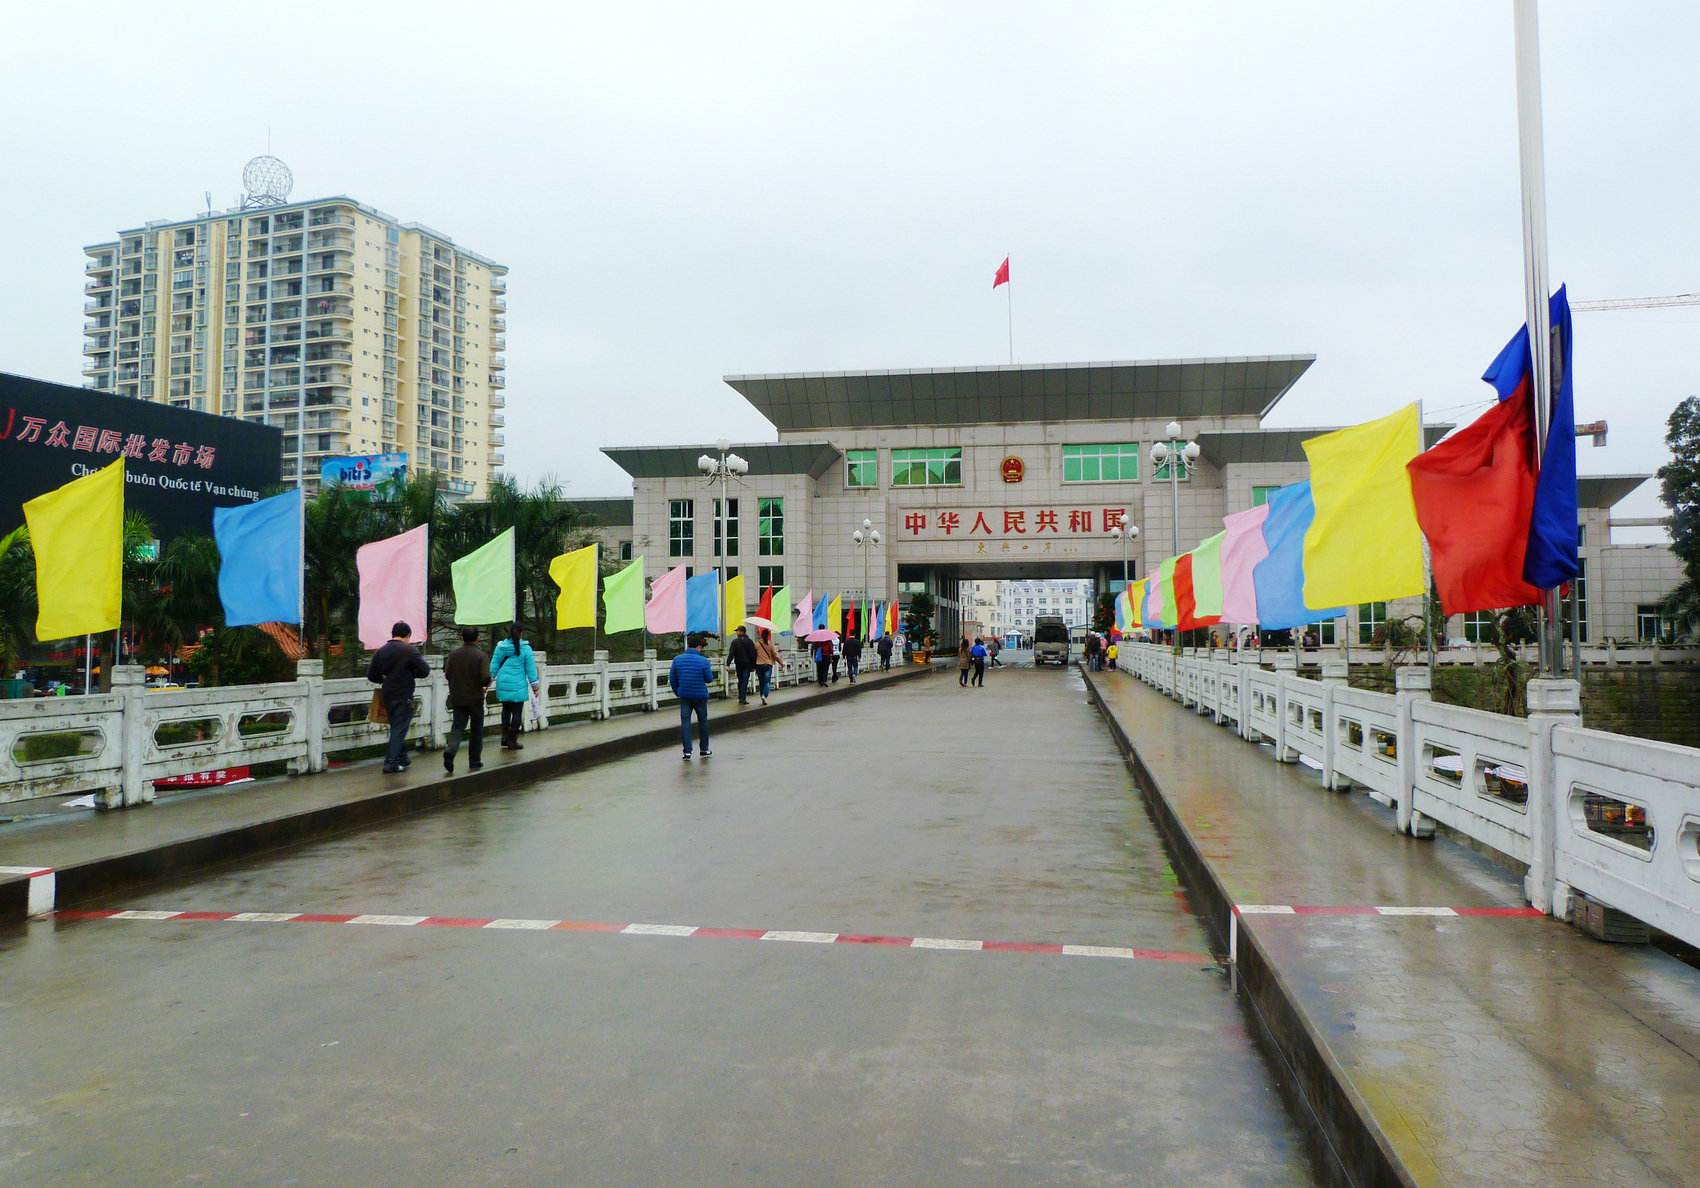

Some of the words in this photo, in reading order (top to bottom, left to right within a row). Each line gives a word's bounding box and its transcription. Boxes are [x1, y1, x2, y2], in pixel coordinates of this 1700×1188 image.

[16, 416, 216, 469] 万众国际批发市场
[126, 470, 156, 486] buôn
[159, 475, 189, 490] Quốc
[905, 508, 1127, 536] 中华人民共和国
